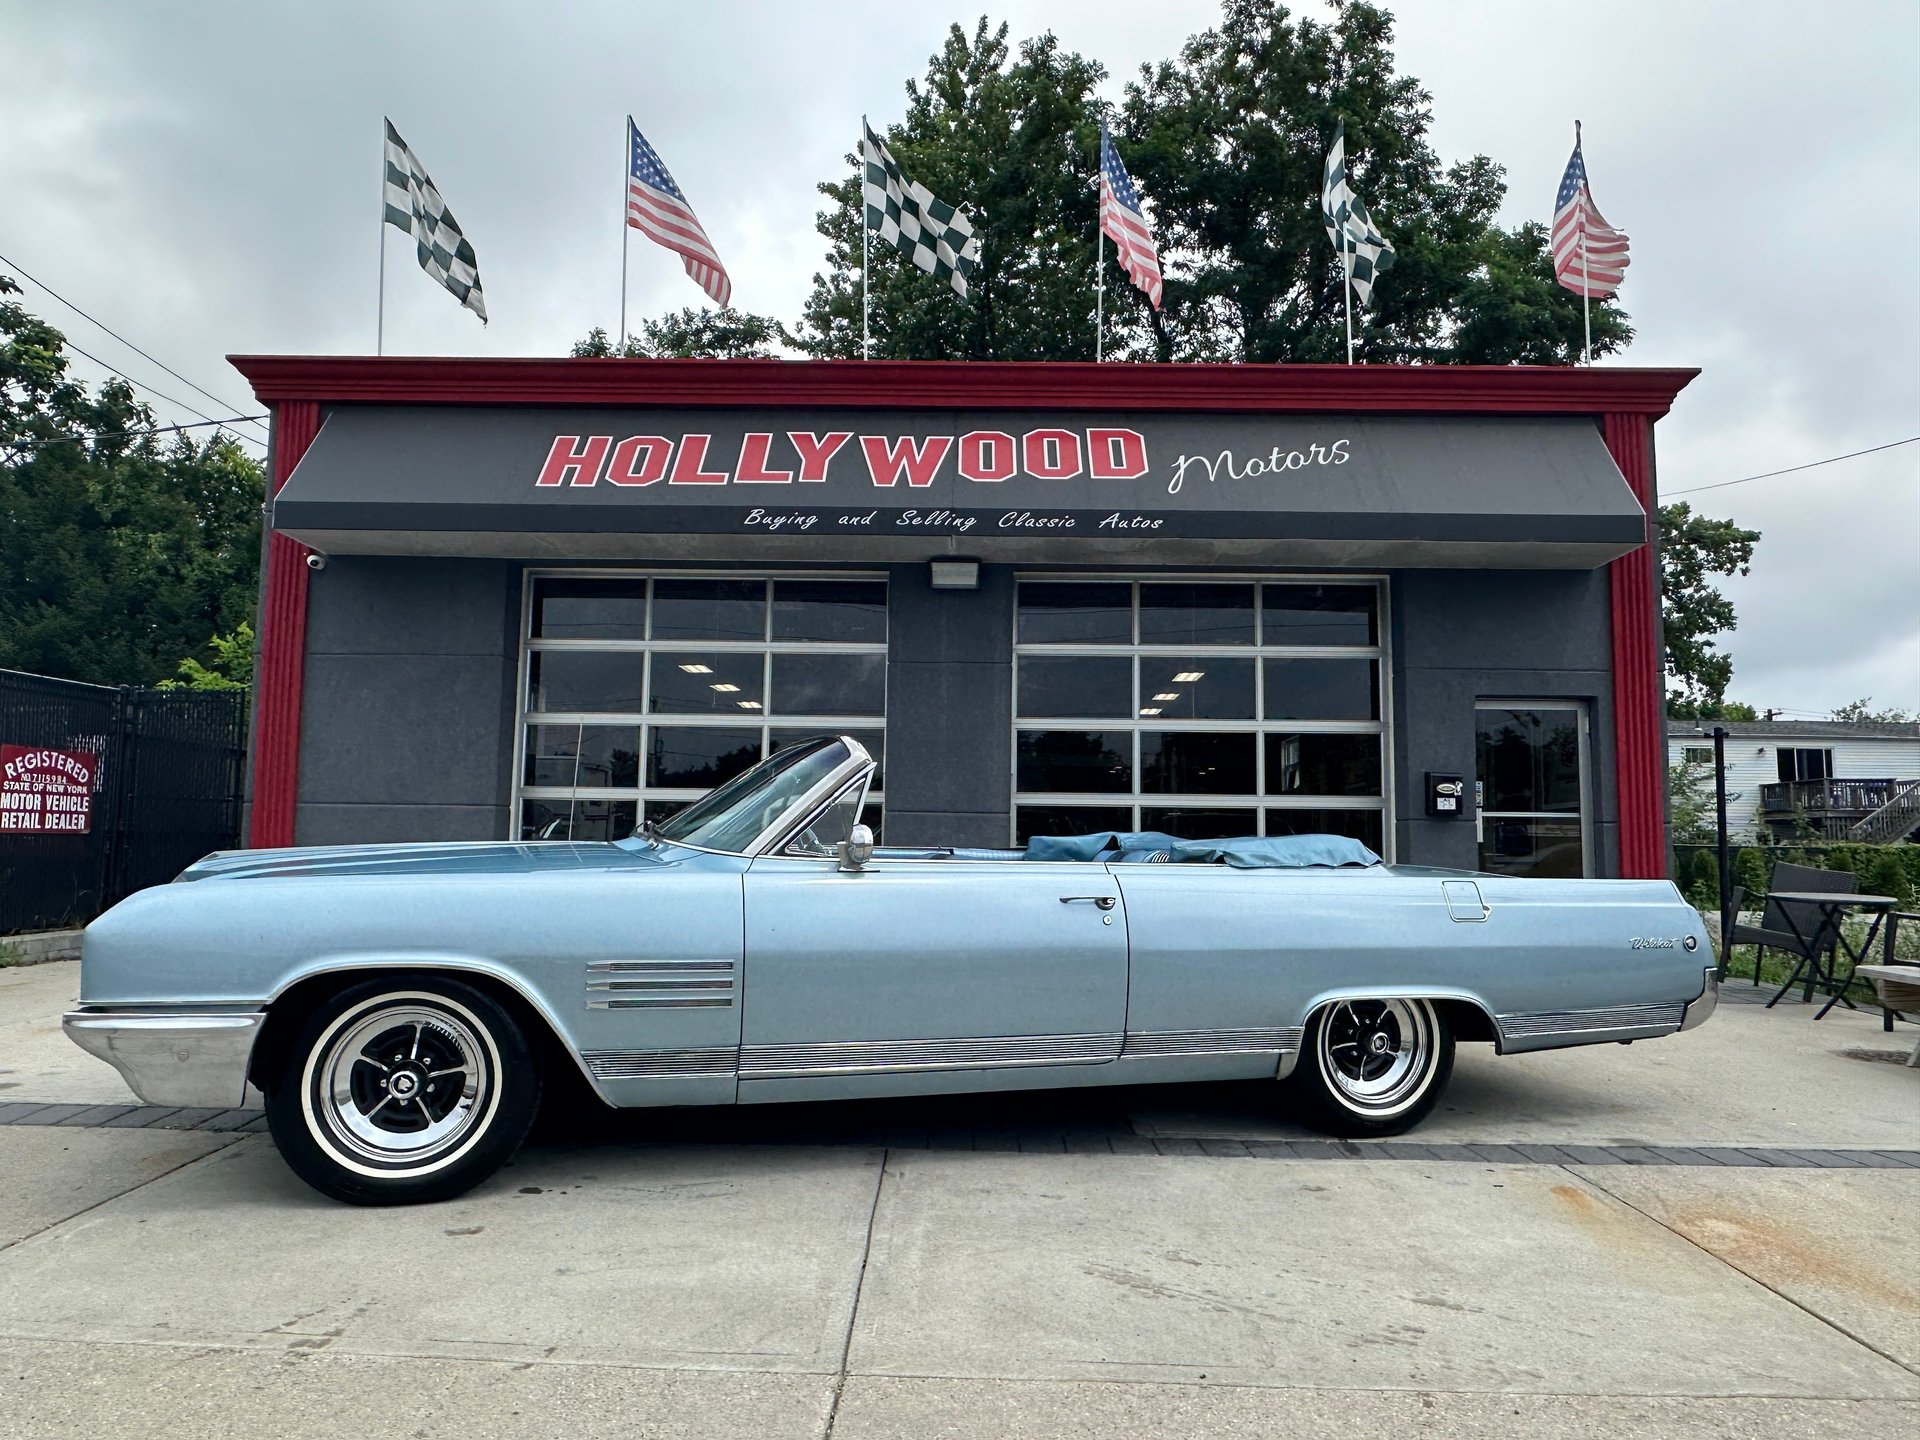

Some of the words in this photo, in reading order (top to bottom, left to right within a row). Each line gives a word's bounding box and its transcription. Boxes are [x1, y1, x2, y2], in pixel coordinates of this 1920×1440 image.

[535, 427, 1150, 488] HOLLYWOOD
[1167, 439, 1351, 495] Motors
[744, 508, 818, 529] Buying
[838, 510, 877, 526] and
[896, 509, 978, 530] Selling
[998, 511, 1076, 530] Classic
[1099, 512, 1164, 530] Autos
[4, 750, 89, 783] REGISTERED
[3, 781, 31, 791] STATE
[32, 783, 45, 792] OF
[46, 784, 65, 793] NEW
[66, 785, 88, 794] YORK
[0, 792, 42, 810] MOTOR
[45, 794, 90, 812] VEHICLE
[0, 811, 41, 829] RETAIL
[44, 813, 86, 830] DEALER
